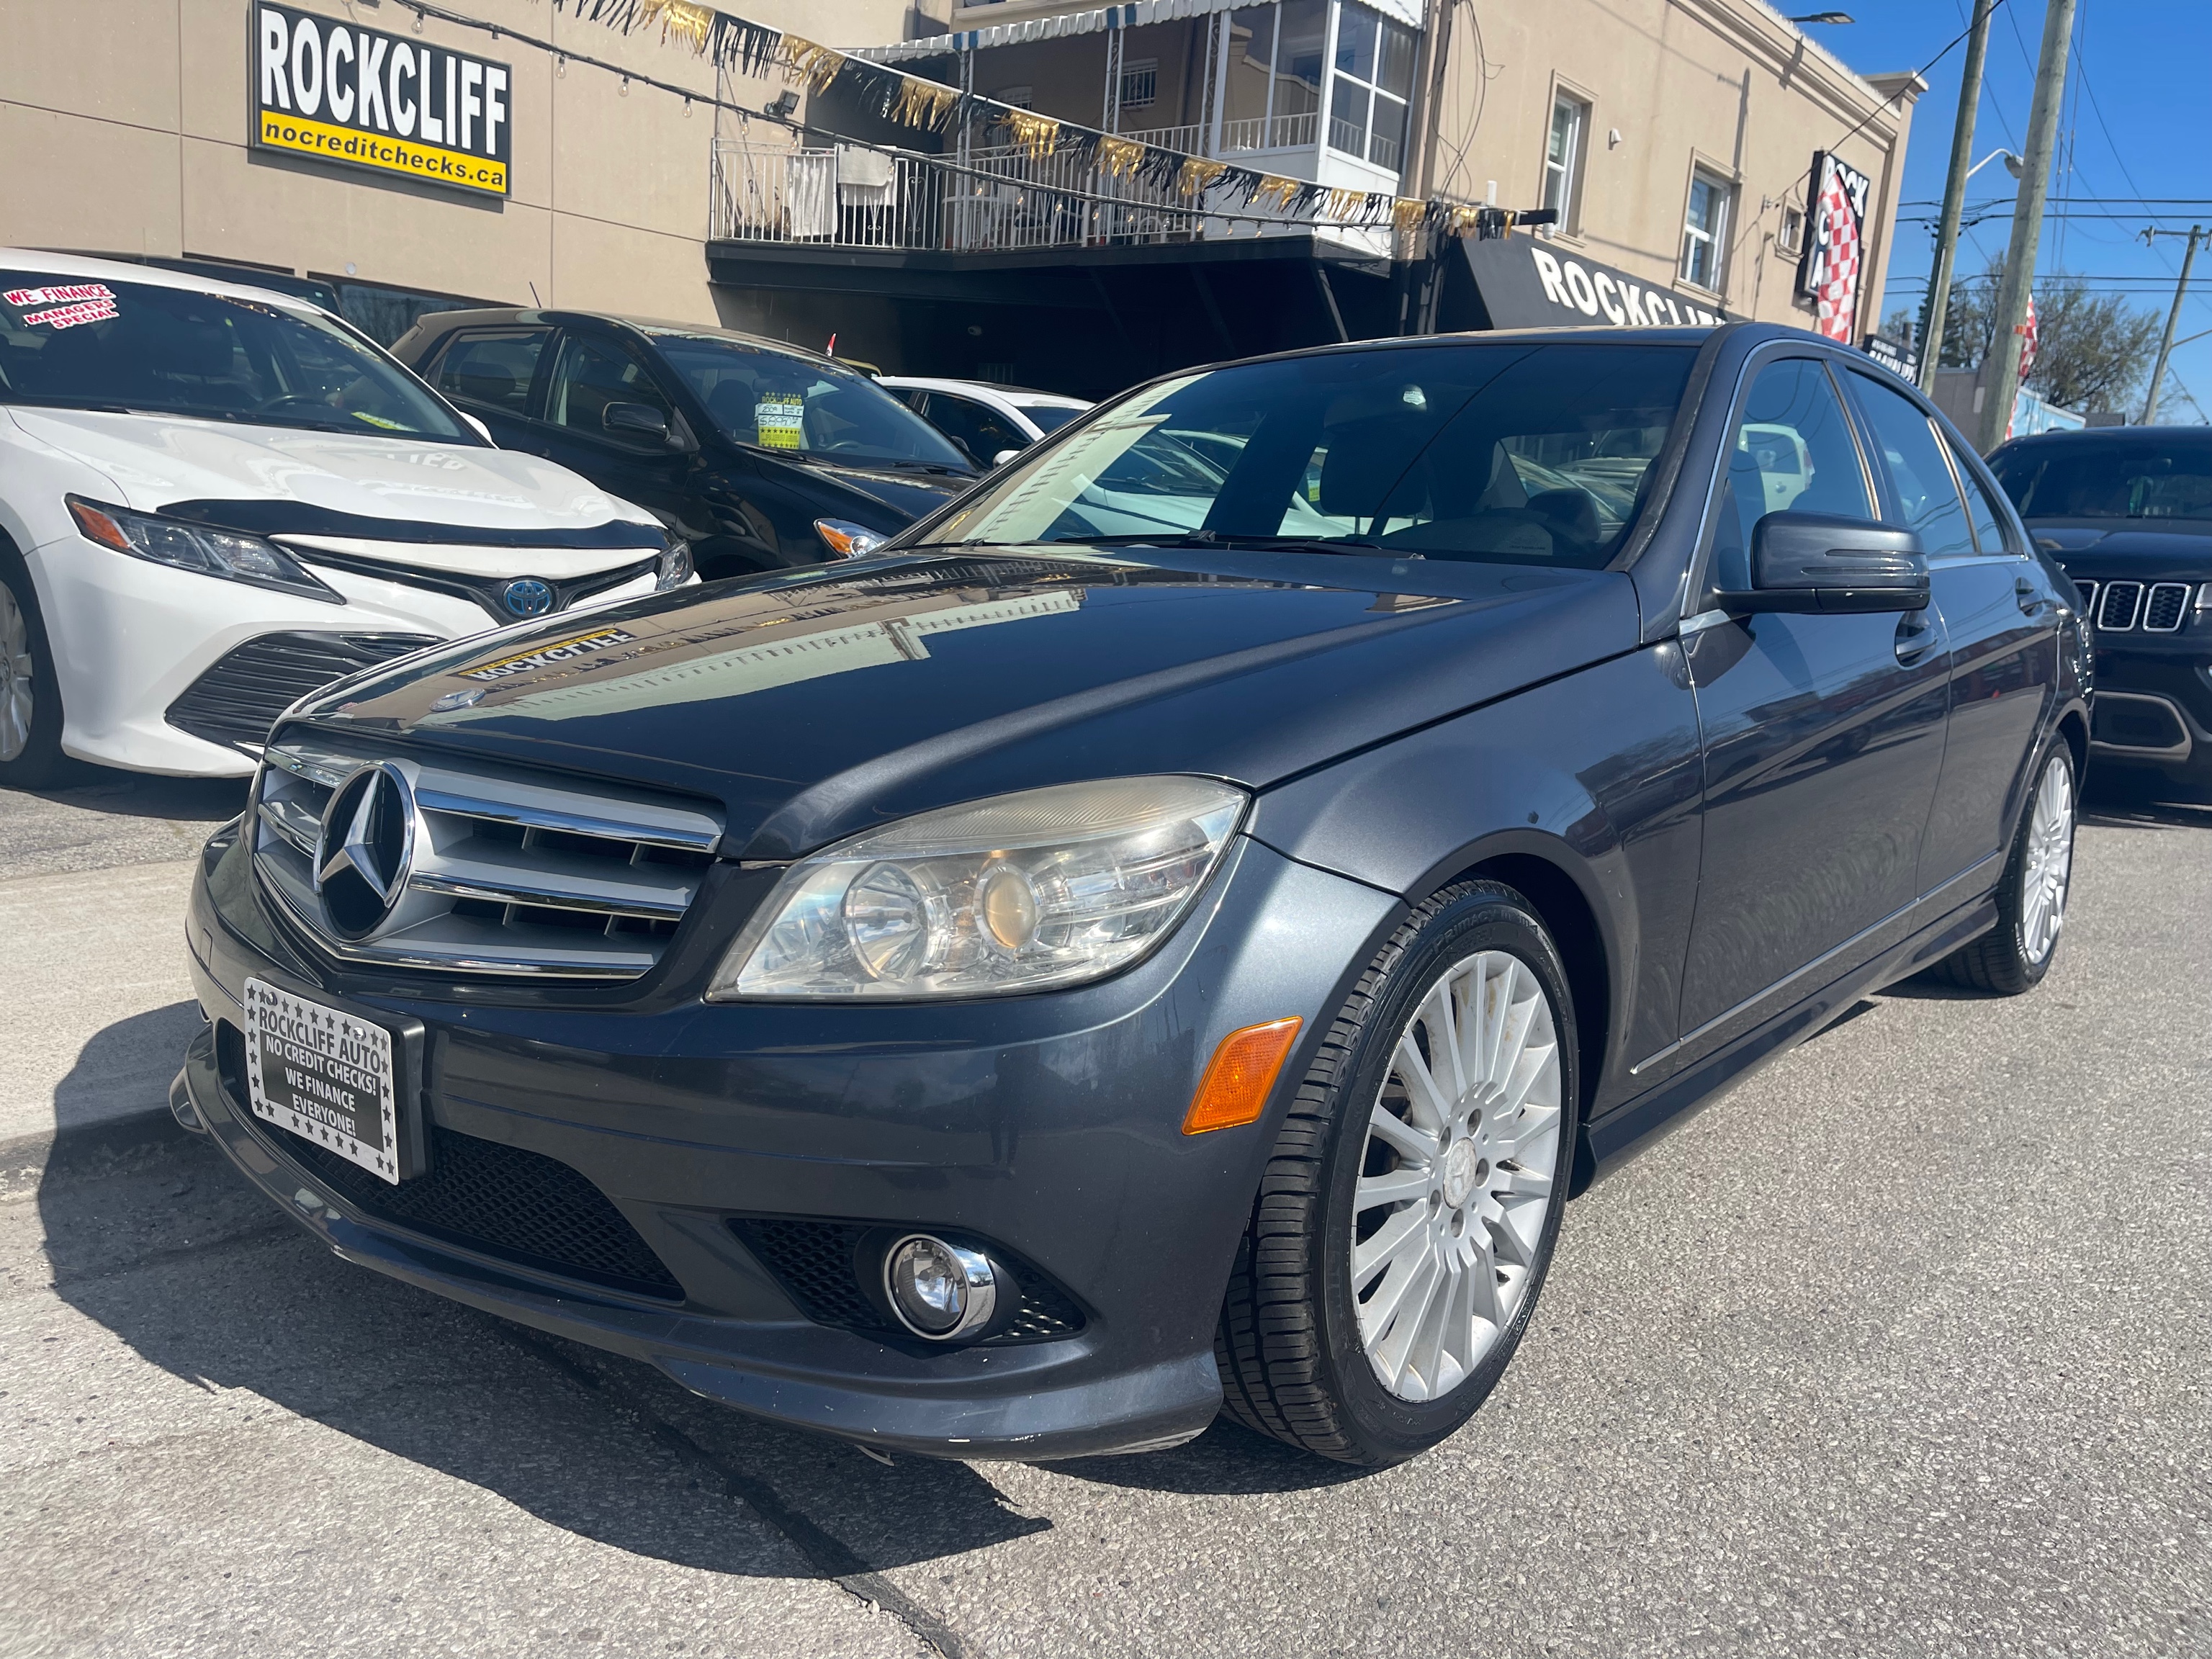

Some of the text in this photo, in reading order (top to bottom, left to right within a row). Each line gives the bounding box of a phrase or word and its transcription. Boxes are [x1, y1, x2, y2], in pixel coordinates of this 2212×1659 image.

[261, 8, 507, 155] ROCKCLIFF
[265, 122, 503, 186] nocreditchecks.ca
[6, 285, 112, 304] WE FINANCE
[26, 300, 114, 323] MANAGERS
[1532, 247, 1727, 326] ROCKC
[53, 309, 116, 328] SPECIAL
[259, 1007, 380, 1074] ROCKCLIFF AUTO
[266, 1035, 377, 1096] NO CREDIT CHECKS!
[285, 1066, 356, 1112] WE FINANCE
[292, 1093, 356, 1138] EVERYONE!
